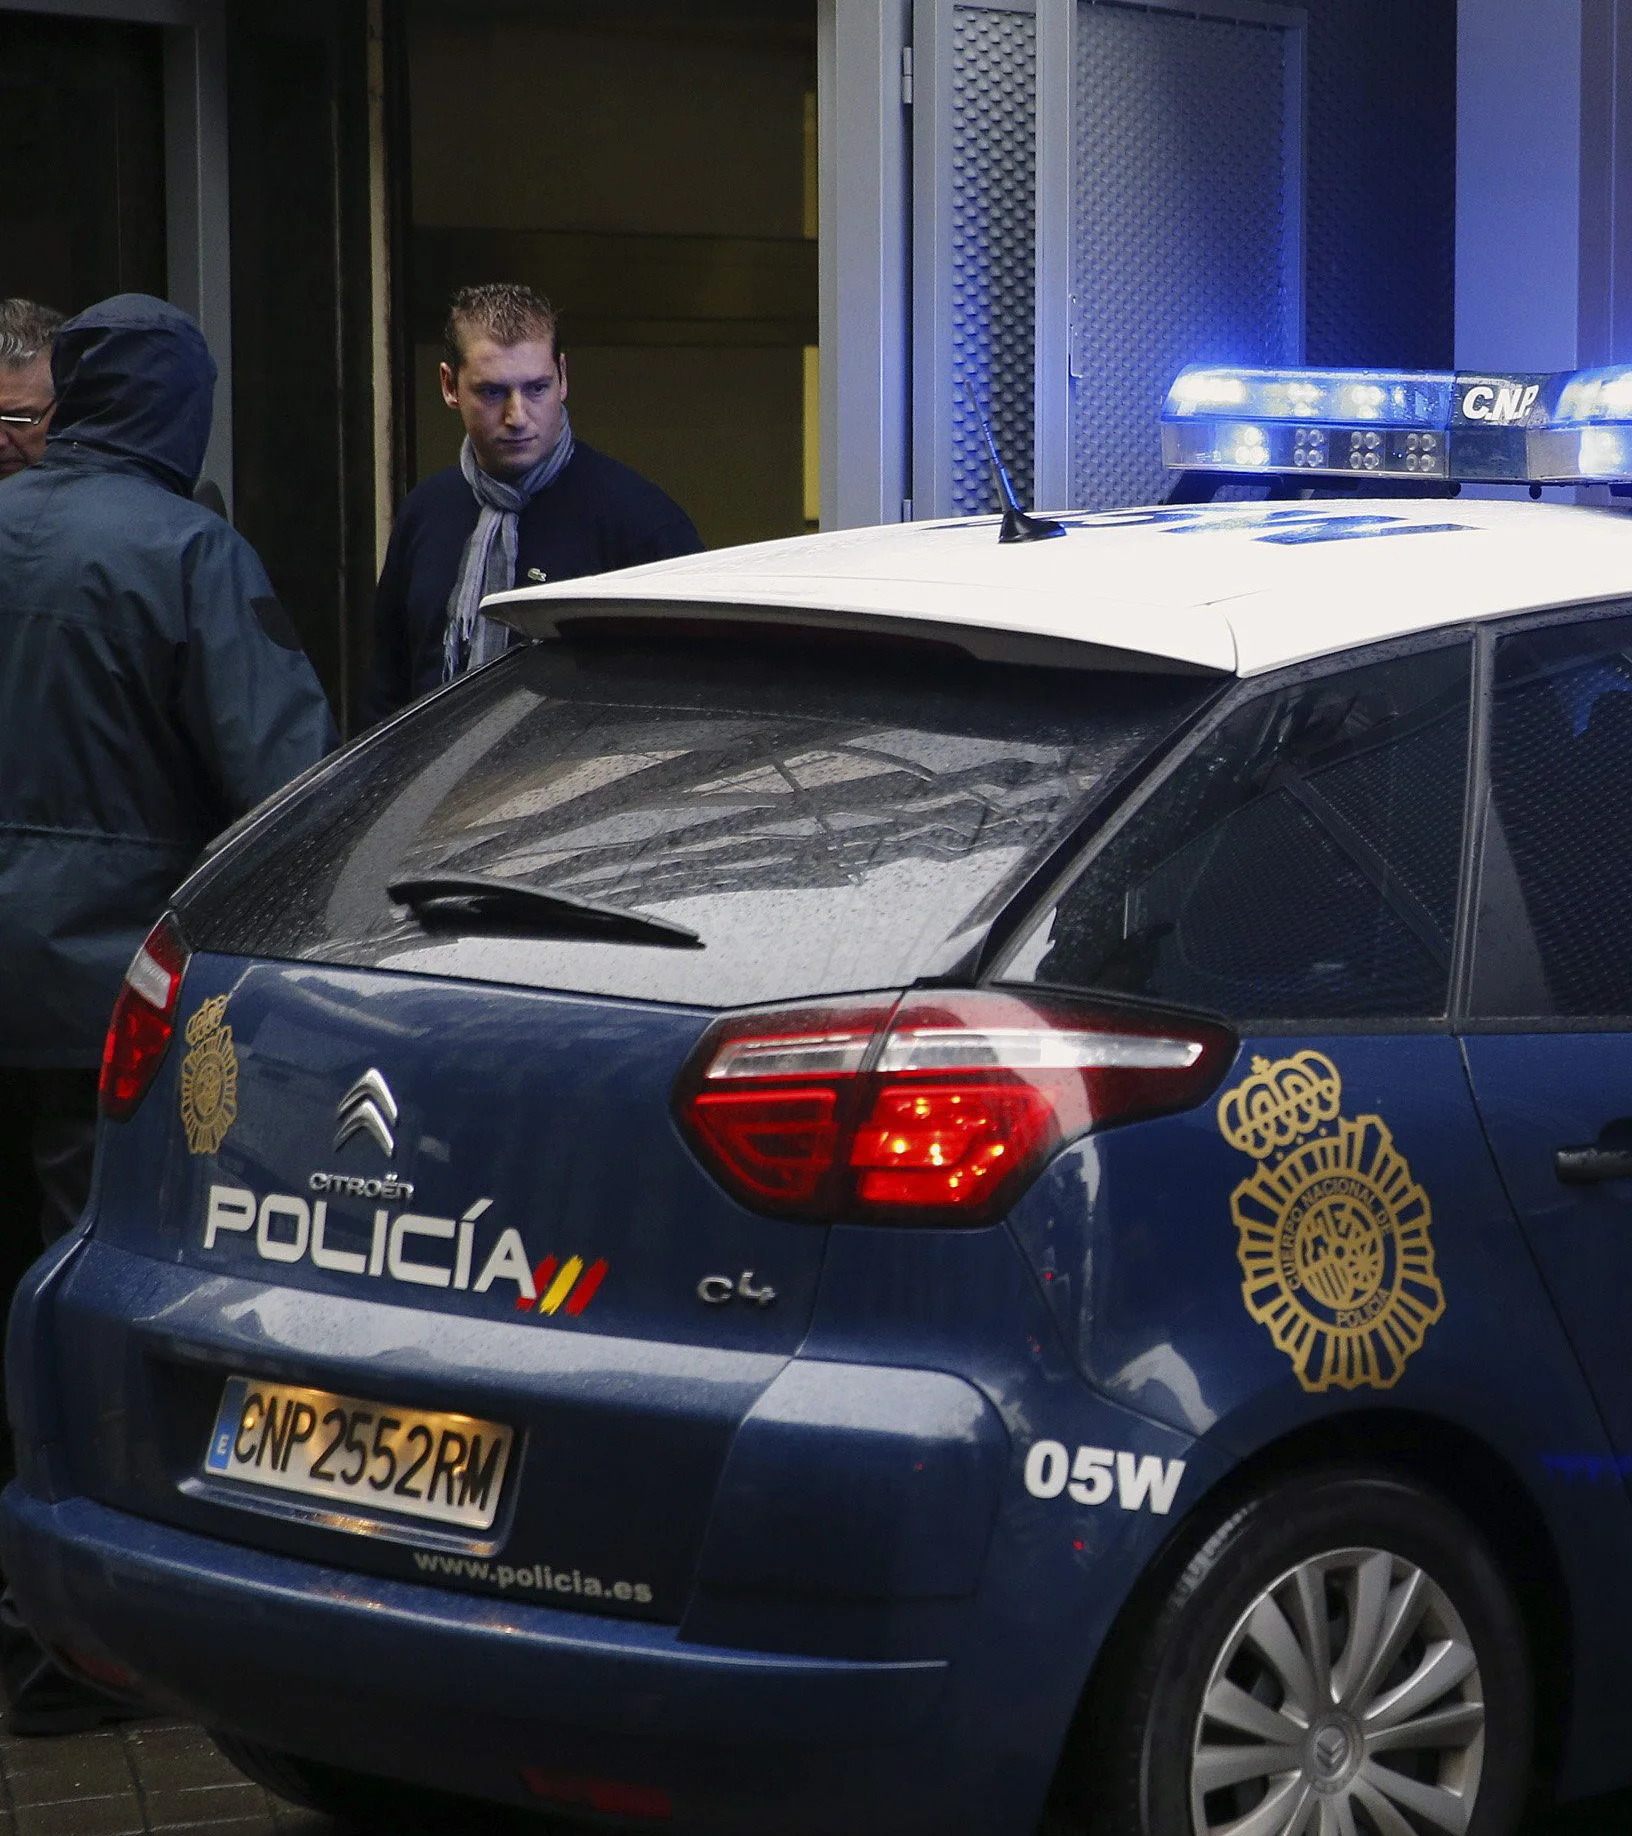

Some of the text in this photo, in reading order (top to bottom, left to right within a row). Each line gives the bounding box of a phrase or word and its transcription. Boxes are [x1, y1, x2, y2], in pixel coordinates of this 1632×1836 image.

[309, 1171, 415, 1199] CITROËN
[204, 1184, 537, 1300] POLICÍA
[697, 1269, 776, 1307] C4
[217, 1433, 231, 1455] E
[233, 1392, 502, 1512] CNP2552RM
[1024, 1439, 1187, 1516] 05W
[414, 1552, 653, 1604] www.policia.es
